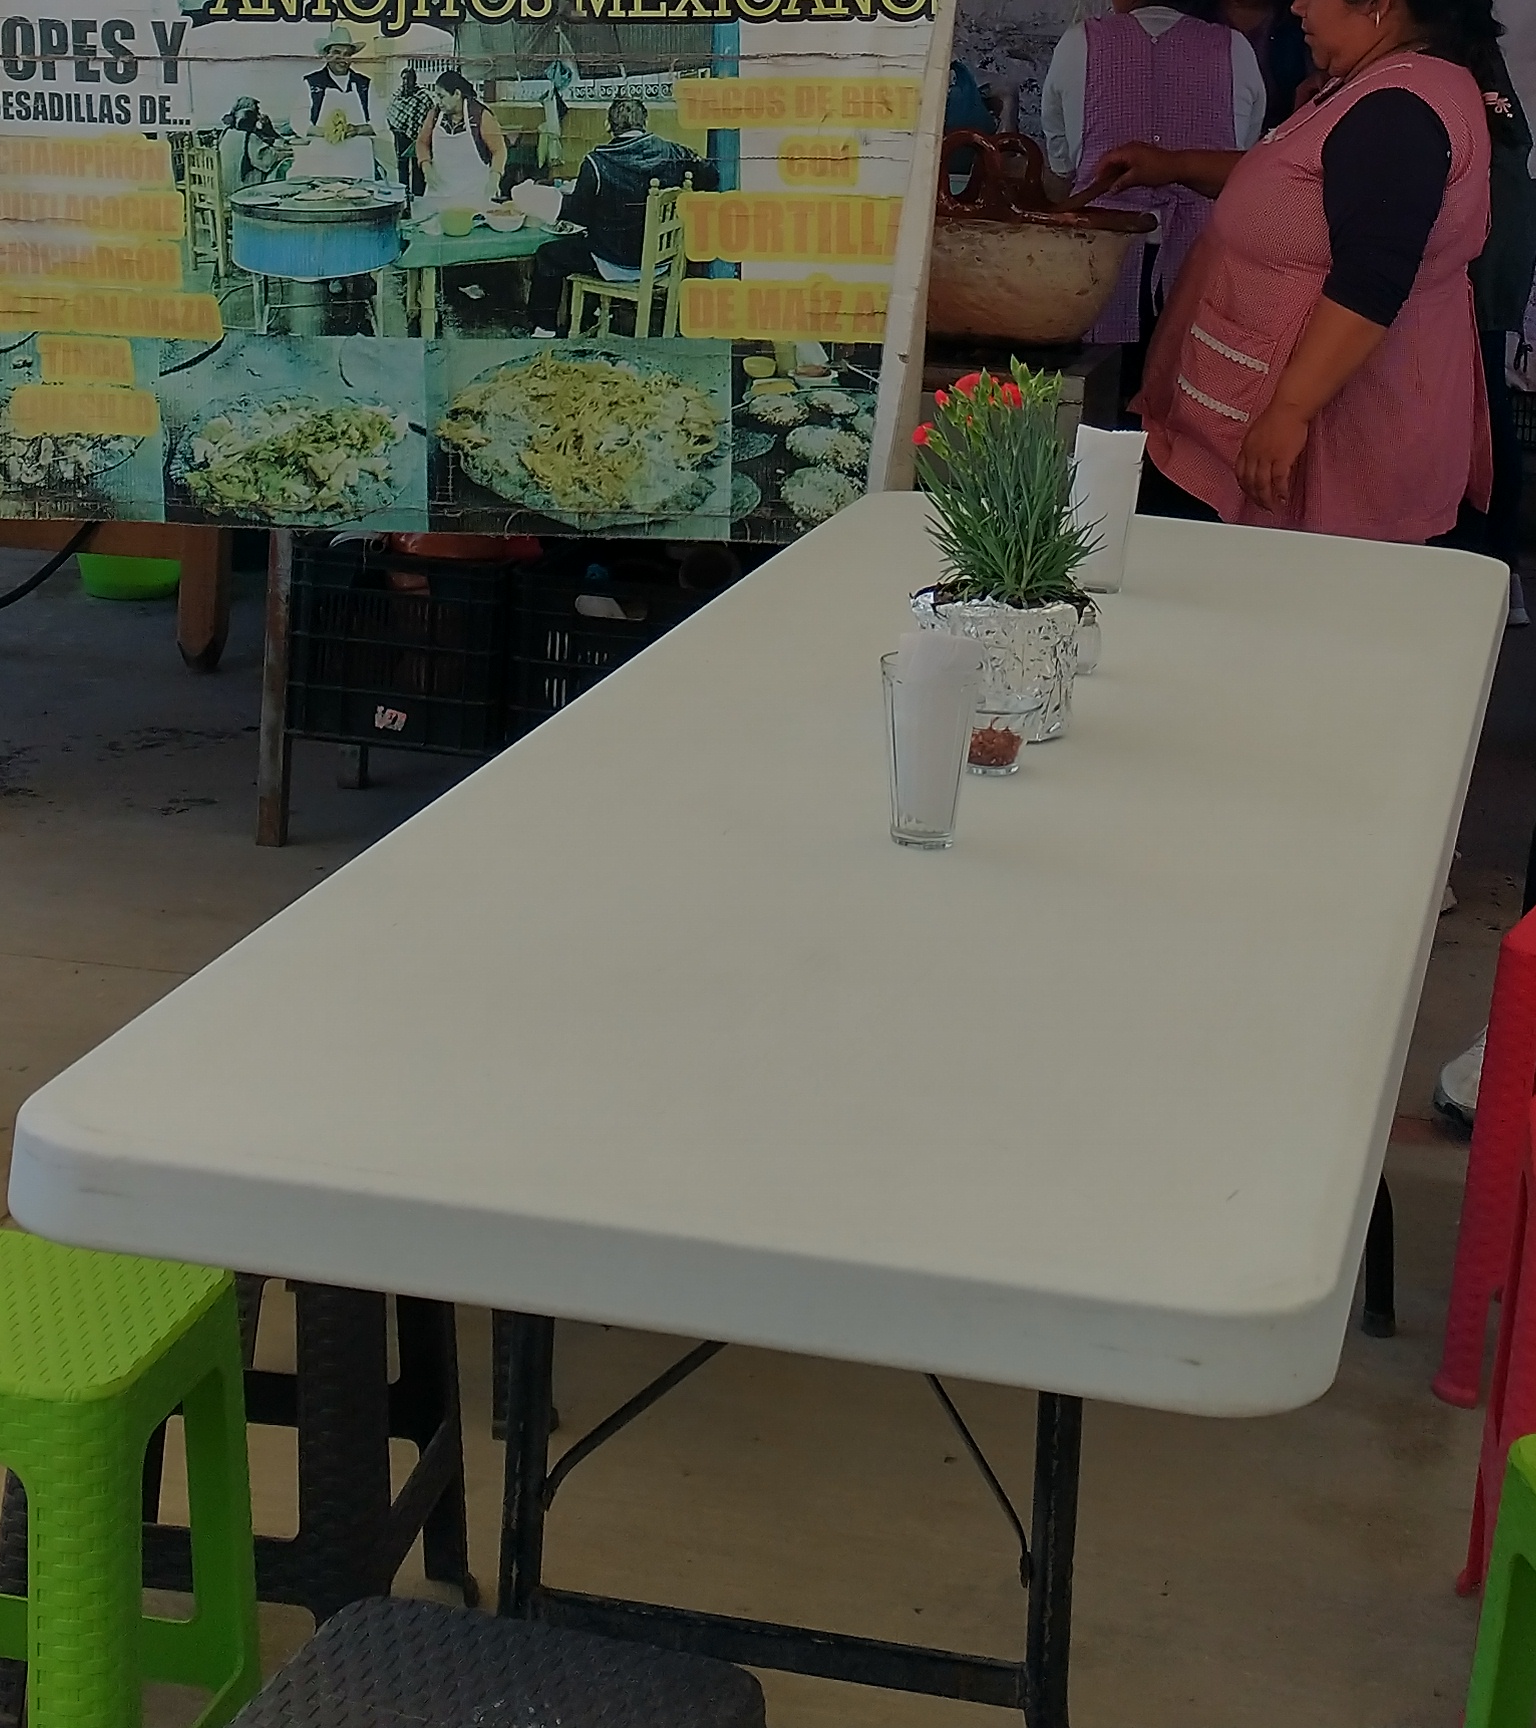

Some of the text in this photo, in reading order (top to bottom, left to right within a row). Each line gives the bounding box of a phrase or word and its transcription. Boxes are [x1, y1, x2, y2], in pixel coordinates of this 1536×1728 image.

[151, 20, 190, 84] Y
[139, 94, 191, 126] DE...
[682, 85, 786, 120] TACOS
[794, 85, 834, 119] DE
[786, 143, 851, 178] CON
[688, 287, 735, 329] DE
[747, 281, 843, 332] MAÍZ
